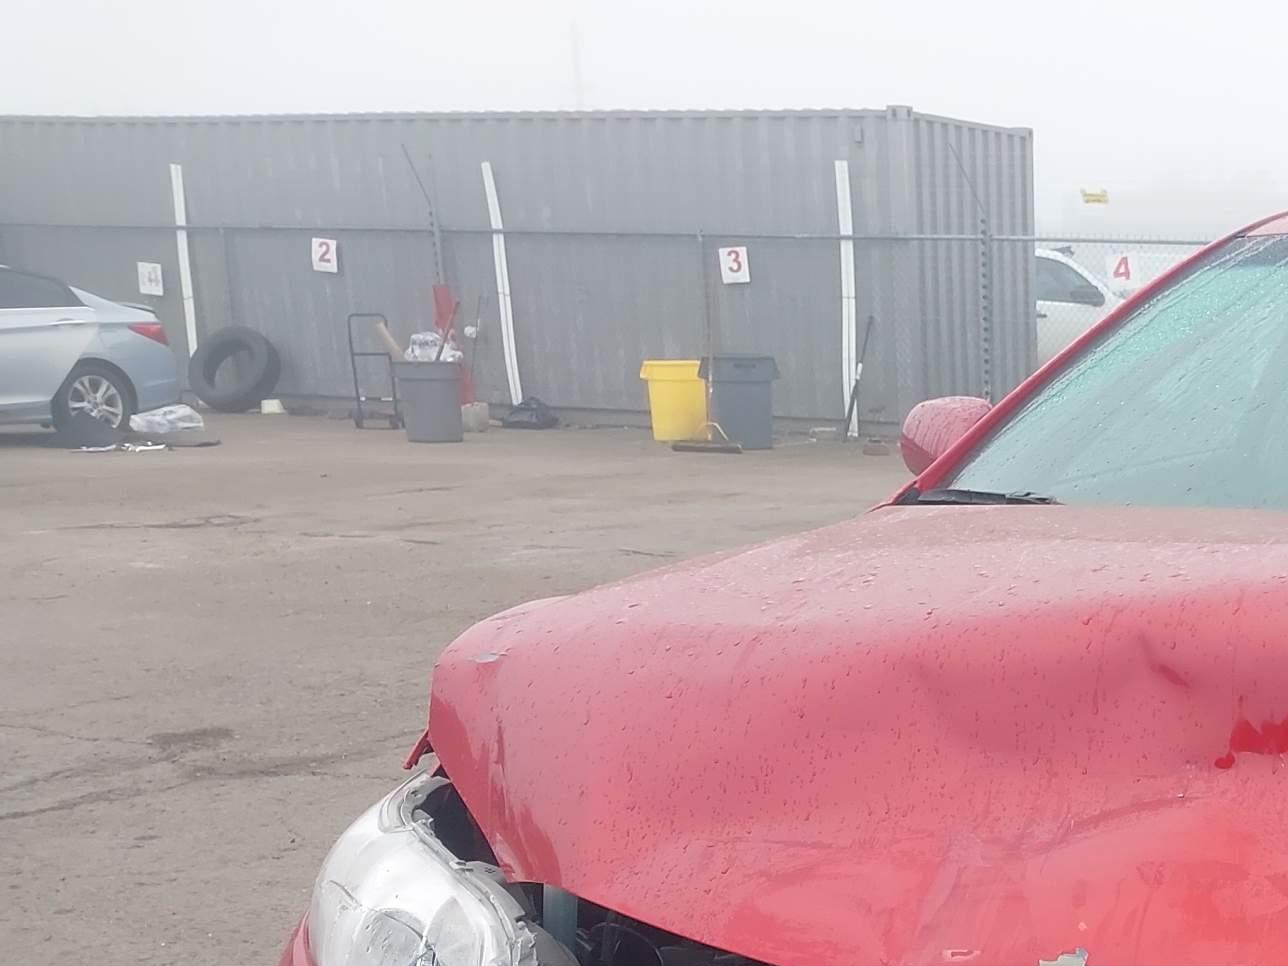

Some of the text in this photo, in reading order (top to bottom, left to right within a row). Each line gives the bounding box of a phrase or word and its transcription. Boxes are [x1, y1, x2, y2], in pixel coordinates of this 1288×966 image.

[318, 241, 331, 264] 2
[727, 250, 742, 273] 3
[1113, 256, 1130, 280] 4
